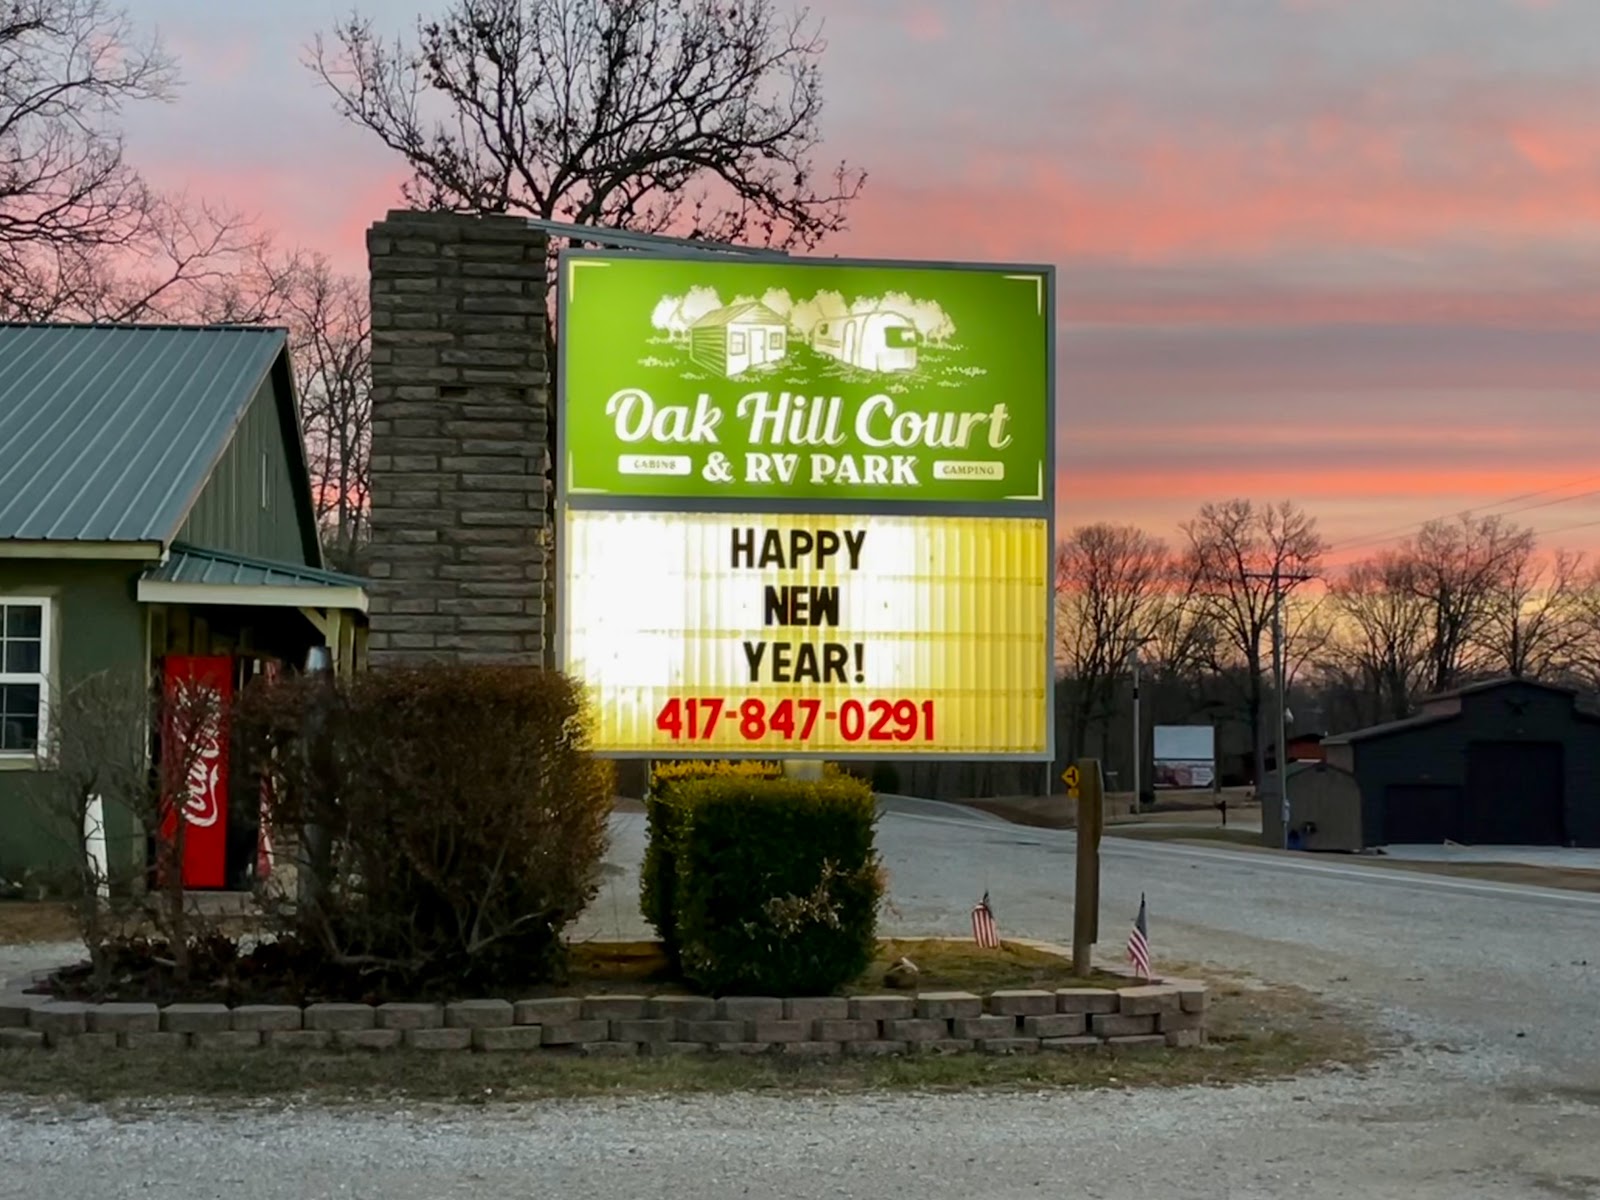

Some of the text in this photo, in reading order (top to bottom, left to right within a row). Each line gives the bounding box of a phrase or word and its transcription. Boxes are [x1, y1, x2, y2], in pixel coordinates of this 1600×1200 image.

[605, 388, 1012, 451] Oak Hill Court
[633, 459, 677, 471] CABINS
[702, 451, 919, 486] & RV PARK
[942, 464, 995, 476] CAMPING
[731, 528, 866, 570] HAPPY
[764, 585, 839, 627] NEW
[743, 641, 865, 683] YEAR!
[656, 698, 934, 741] 417-847-0291
